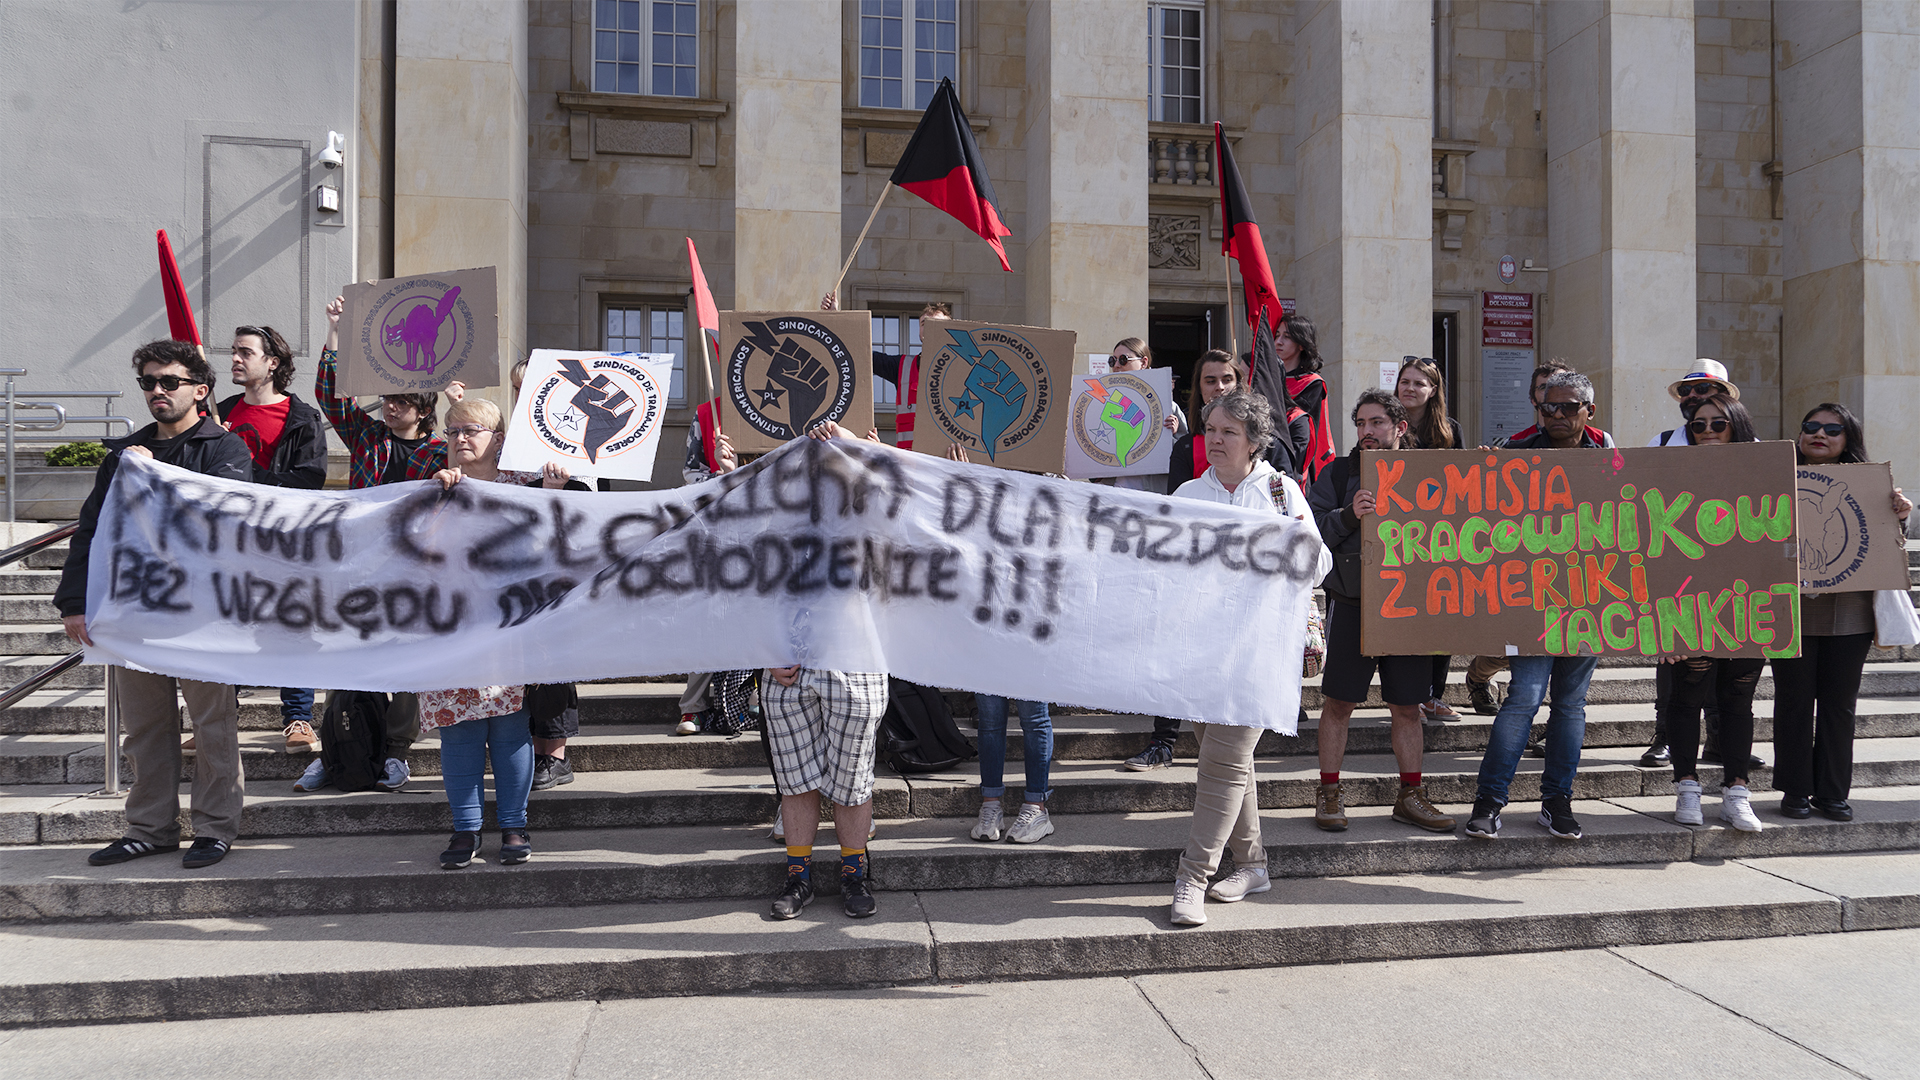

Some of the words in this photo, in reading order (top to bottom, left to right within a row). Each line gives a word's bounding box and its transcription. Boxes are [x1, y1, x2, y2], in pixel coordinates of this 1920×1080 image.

[779, 321, 833, 345] SINDICATO
[981, 333, 1034, 360] SINDICATO
[831, 344, 845, 359] DE
[593, 360, 646, 381] SINDICATO
[1031, 360, 1044, 375] DE
[642, 381, 654, 392] DE
[732, 345, 785, 436] LATINOAMERICANOS
[764, 391, 776, 401] PL
[930, 352, 977, 447] LATINOAMERICANOS
[1108, 377, 1148, 393] SINDICATO
[1146, 393, 1156, 403] DE
[534, 377, 577, 454] LATINOAMERICANOS
[562, 415, 575, 423] PL
[959, 401, 971, 410] PL
[1003, 377, 1048, 448] TRABAJADORES
[605, 394, 657, 452] TRABAJADORES
[111, 474, 349, 562] PRAWA
[942, 474, 1062, 546] DLA
[1086, 495, 1322, 582] KAŻDEGO
[1813, 558, 1864, 588] INICJATYWA
[1844, 493, 1870, 559] PRACOWNICZA
[109, 544, 193, 612] BEZ
[1379, 570, 1418, 619] Z
